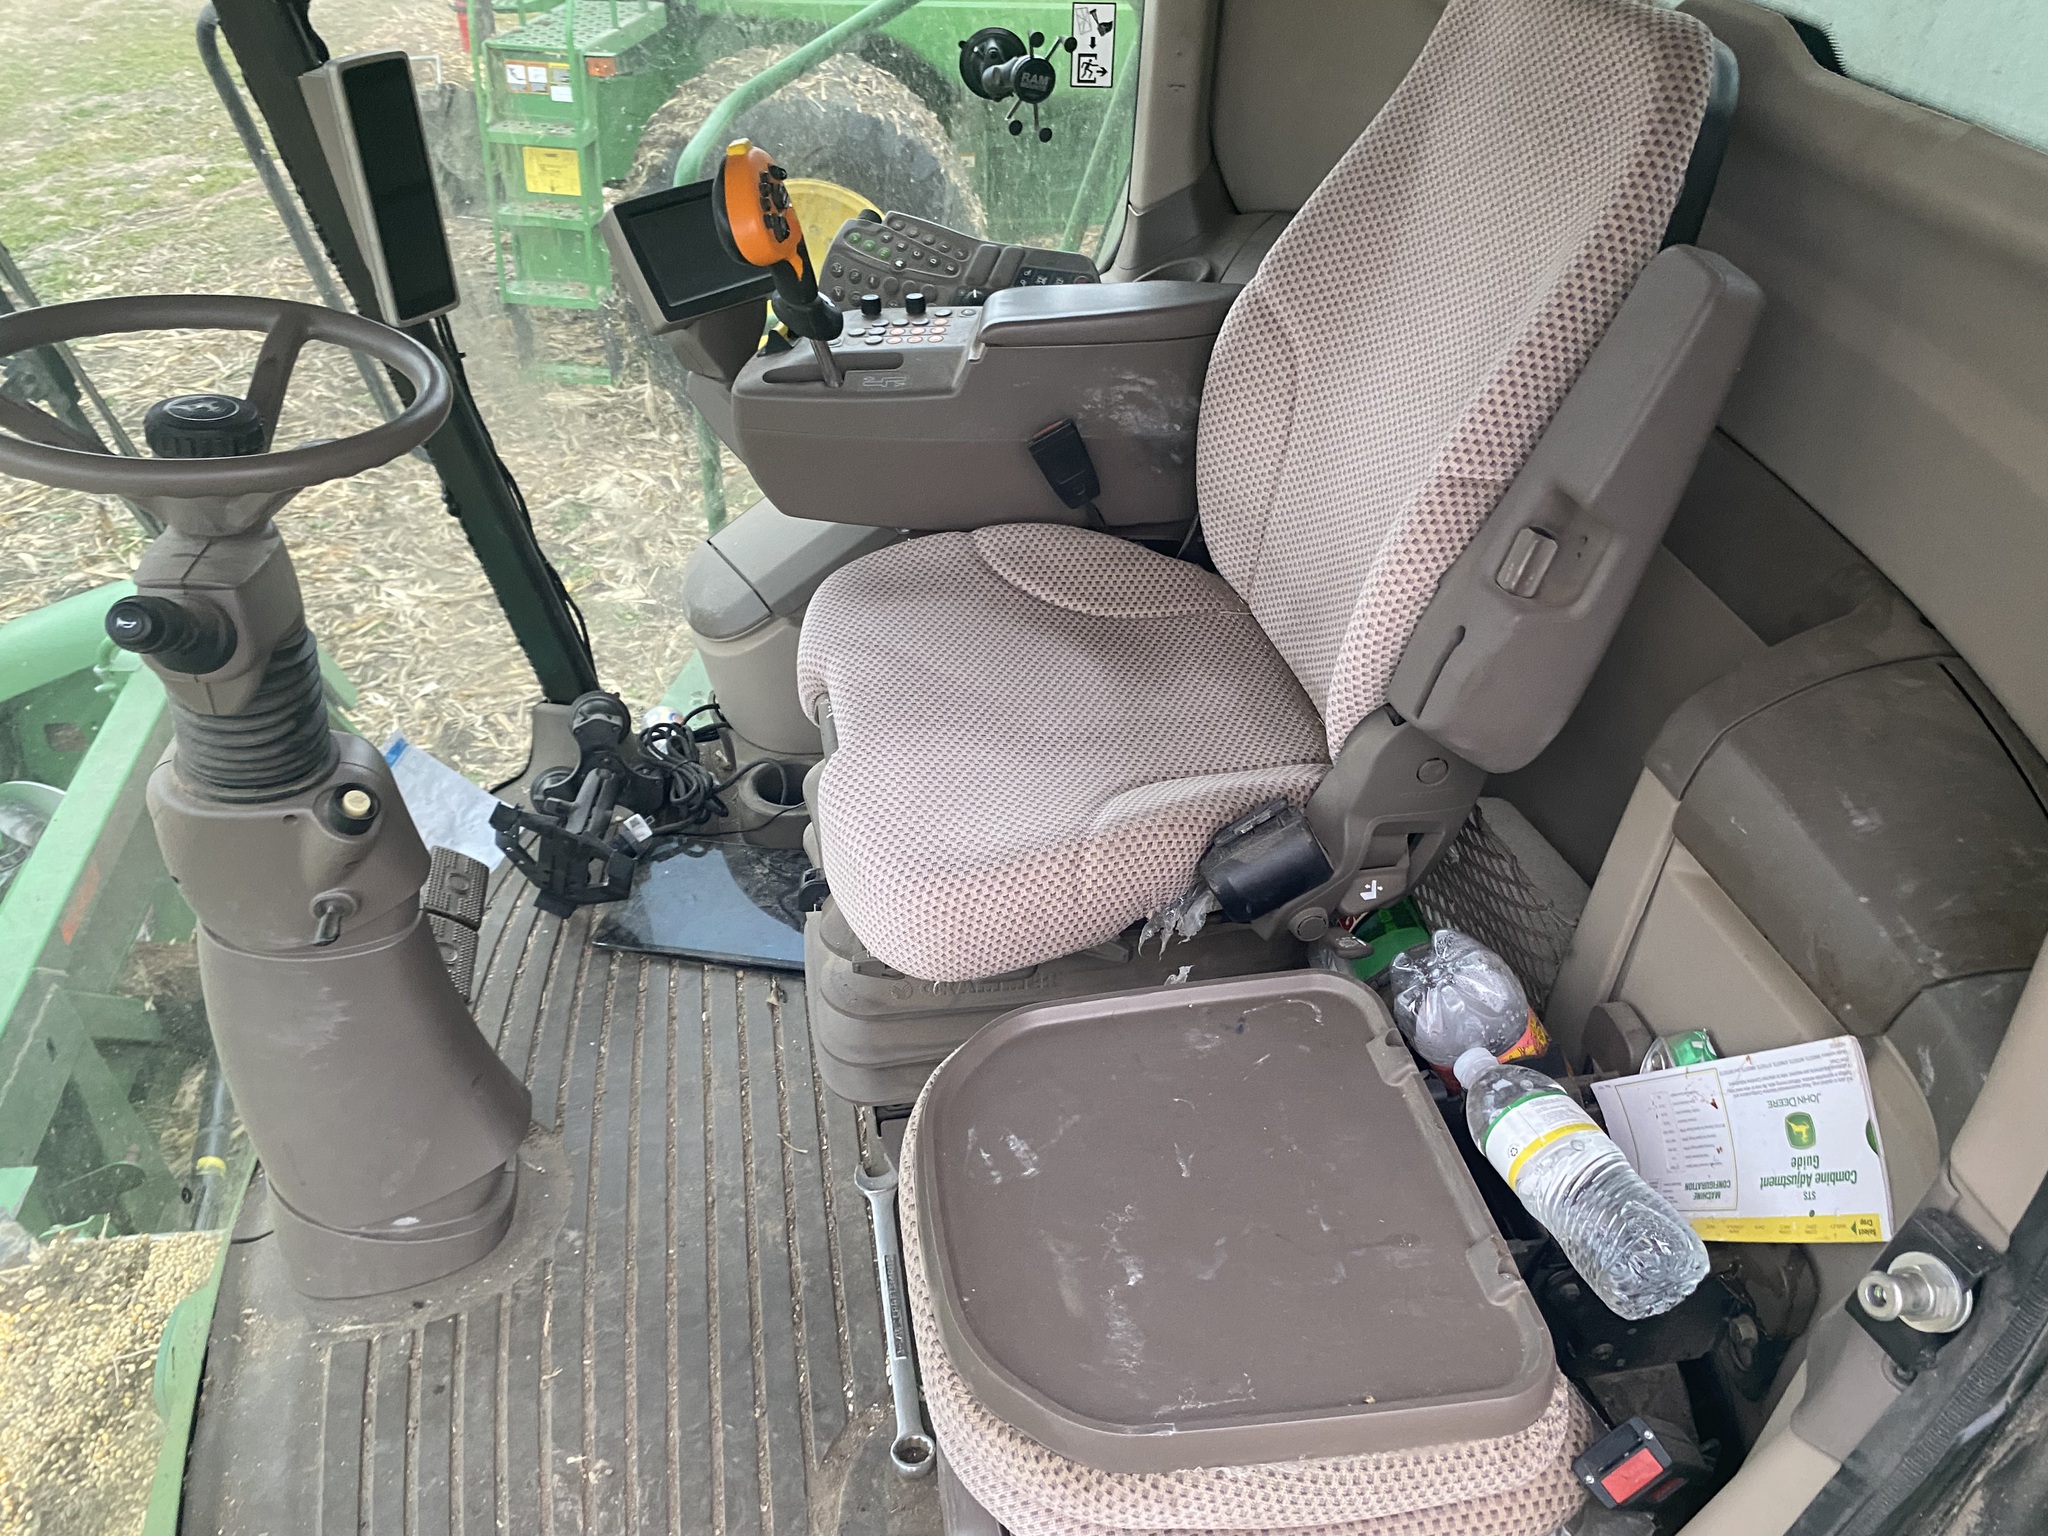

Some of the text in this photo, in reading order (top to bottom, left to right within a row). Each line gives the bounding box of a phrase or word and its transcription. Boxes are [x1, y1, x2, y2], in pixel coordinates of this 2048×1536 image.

[1021, 72, 1049, 86] RAM
[1767, 1092, 1822, 1109] JOHN DEERE
[1791, 1155, 1819, 1169] Guide
[1684, 1180, 1731, 1190] CONFIGURATION
[1760, 1170, 1857, 1190] Combine Adjustment
[1693, 1191, 1721, 1200] MACHINE
[1803, 1191, 1816, 1201] STS
[1859, 1218, 1873, 1227] Crop
[1858, 1227, 1877, 1236] Select
